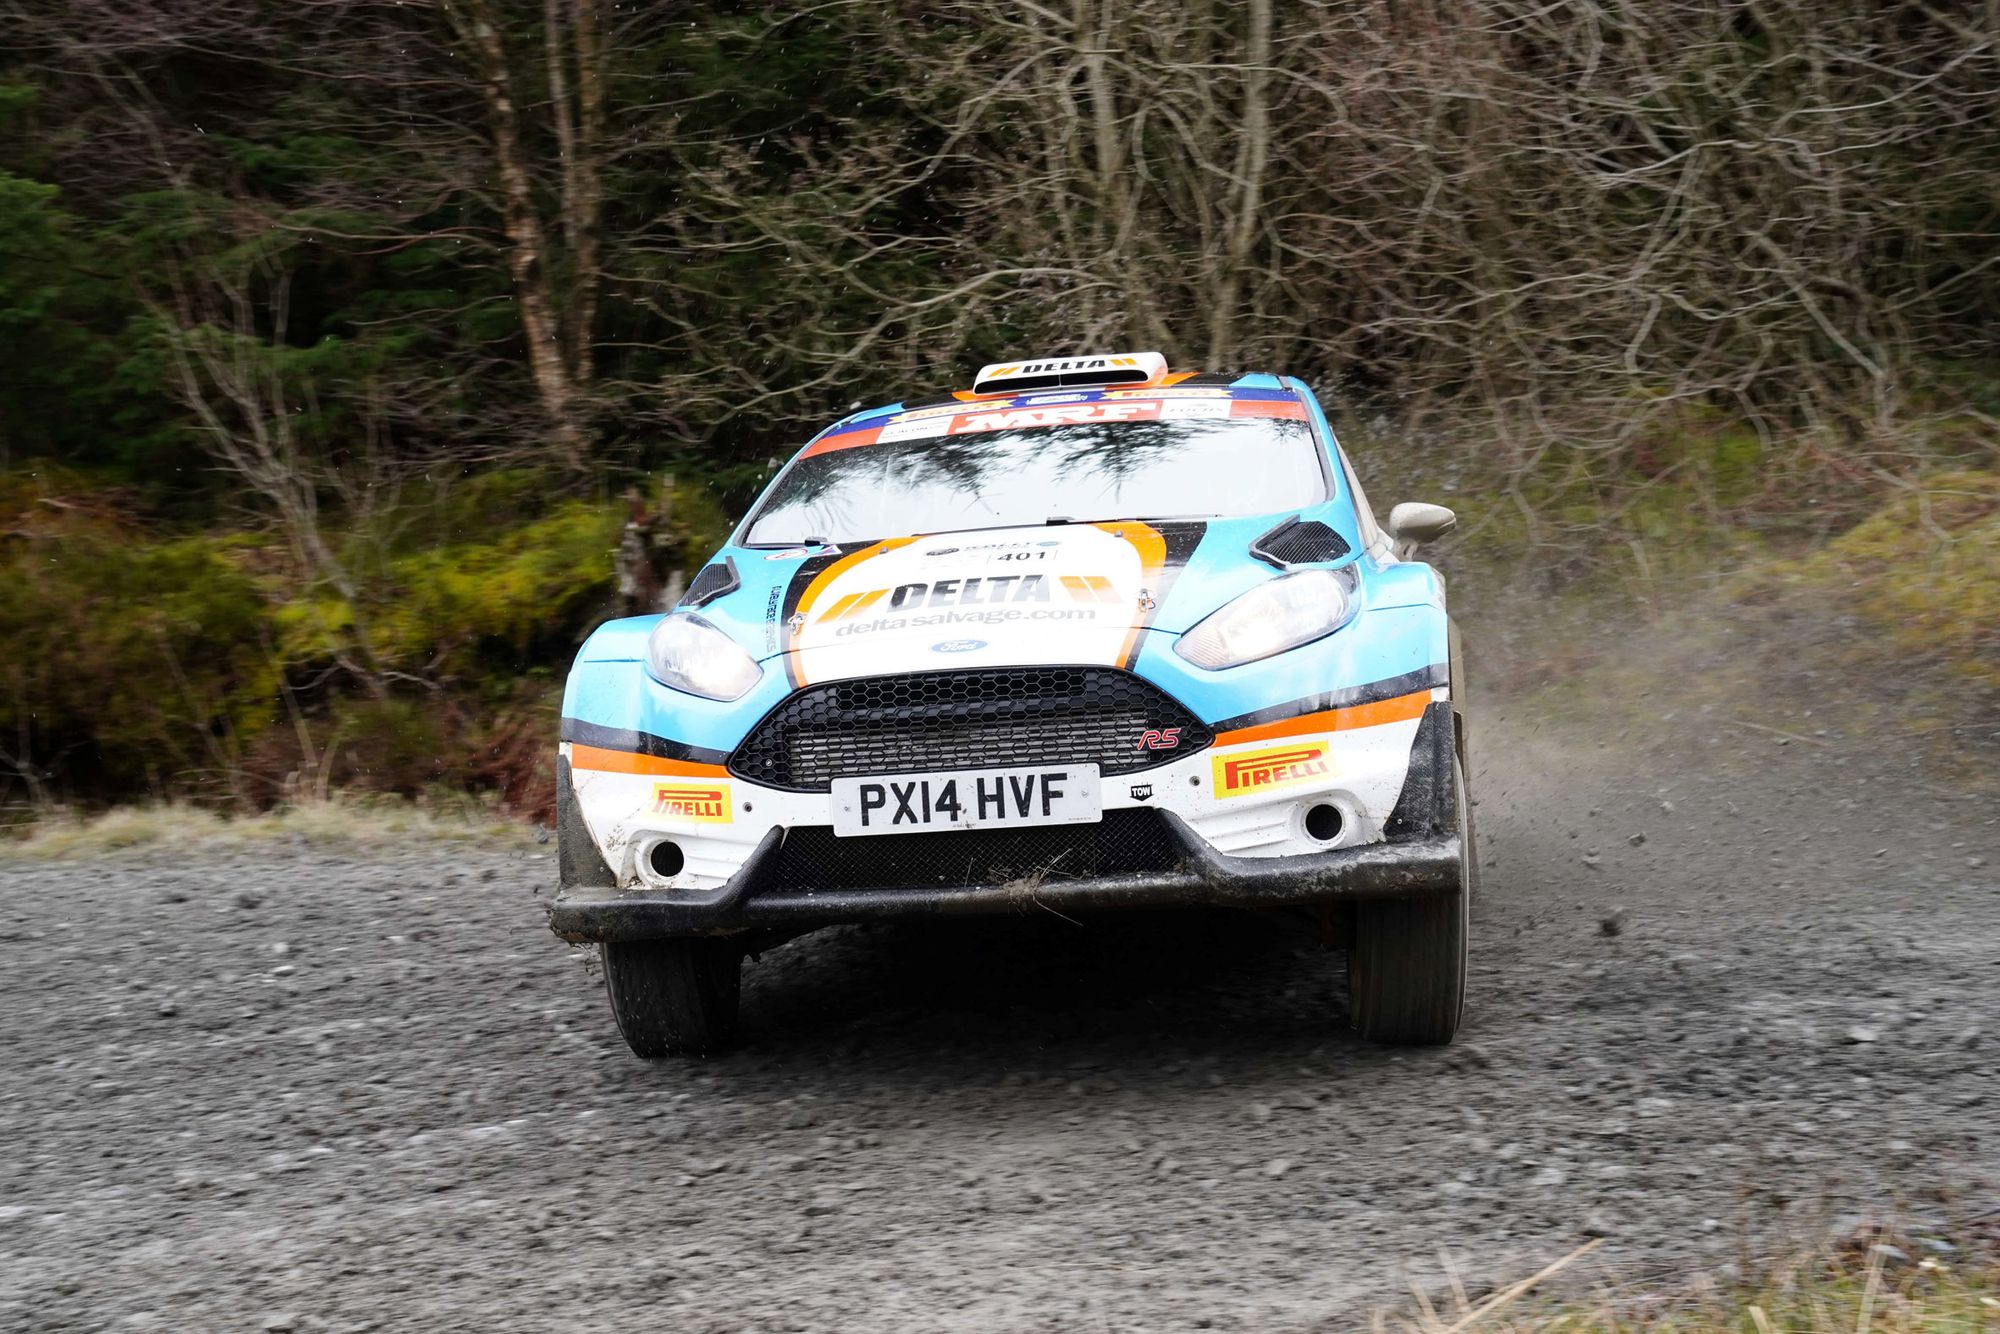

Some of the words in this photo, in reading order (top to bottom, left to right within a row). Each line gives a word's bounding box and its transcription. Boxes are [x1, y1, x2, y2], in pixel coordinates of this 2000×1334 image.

[1022, 360, 1105, 373] DELTA
[955, 403, 1156, 432] MRF
[997, 551, 1046, 561] 401
[887, 575, 1051, 613] DELTA
[1138, 728, 1182, 750] RS
[1225, 749, 1330, 790] PIRELLI
[652, 789, 722, 816] PIRELLI
[860, 779, 962, 826] PX14
[976, 773, 1068, 820] HVF
[1131, 786, 1151, 796] TOW
